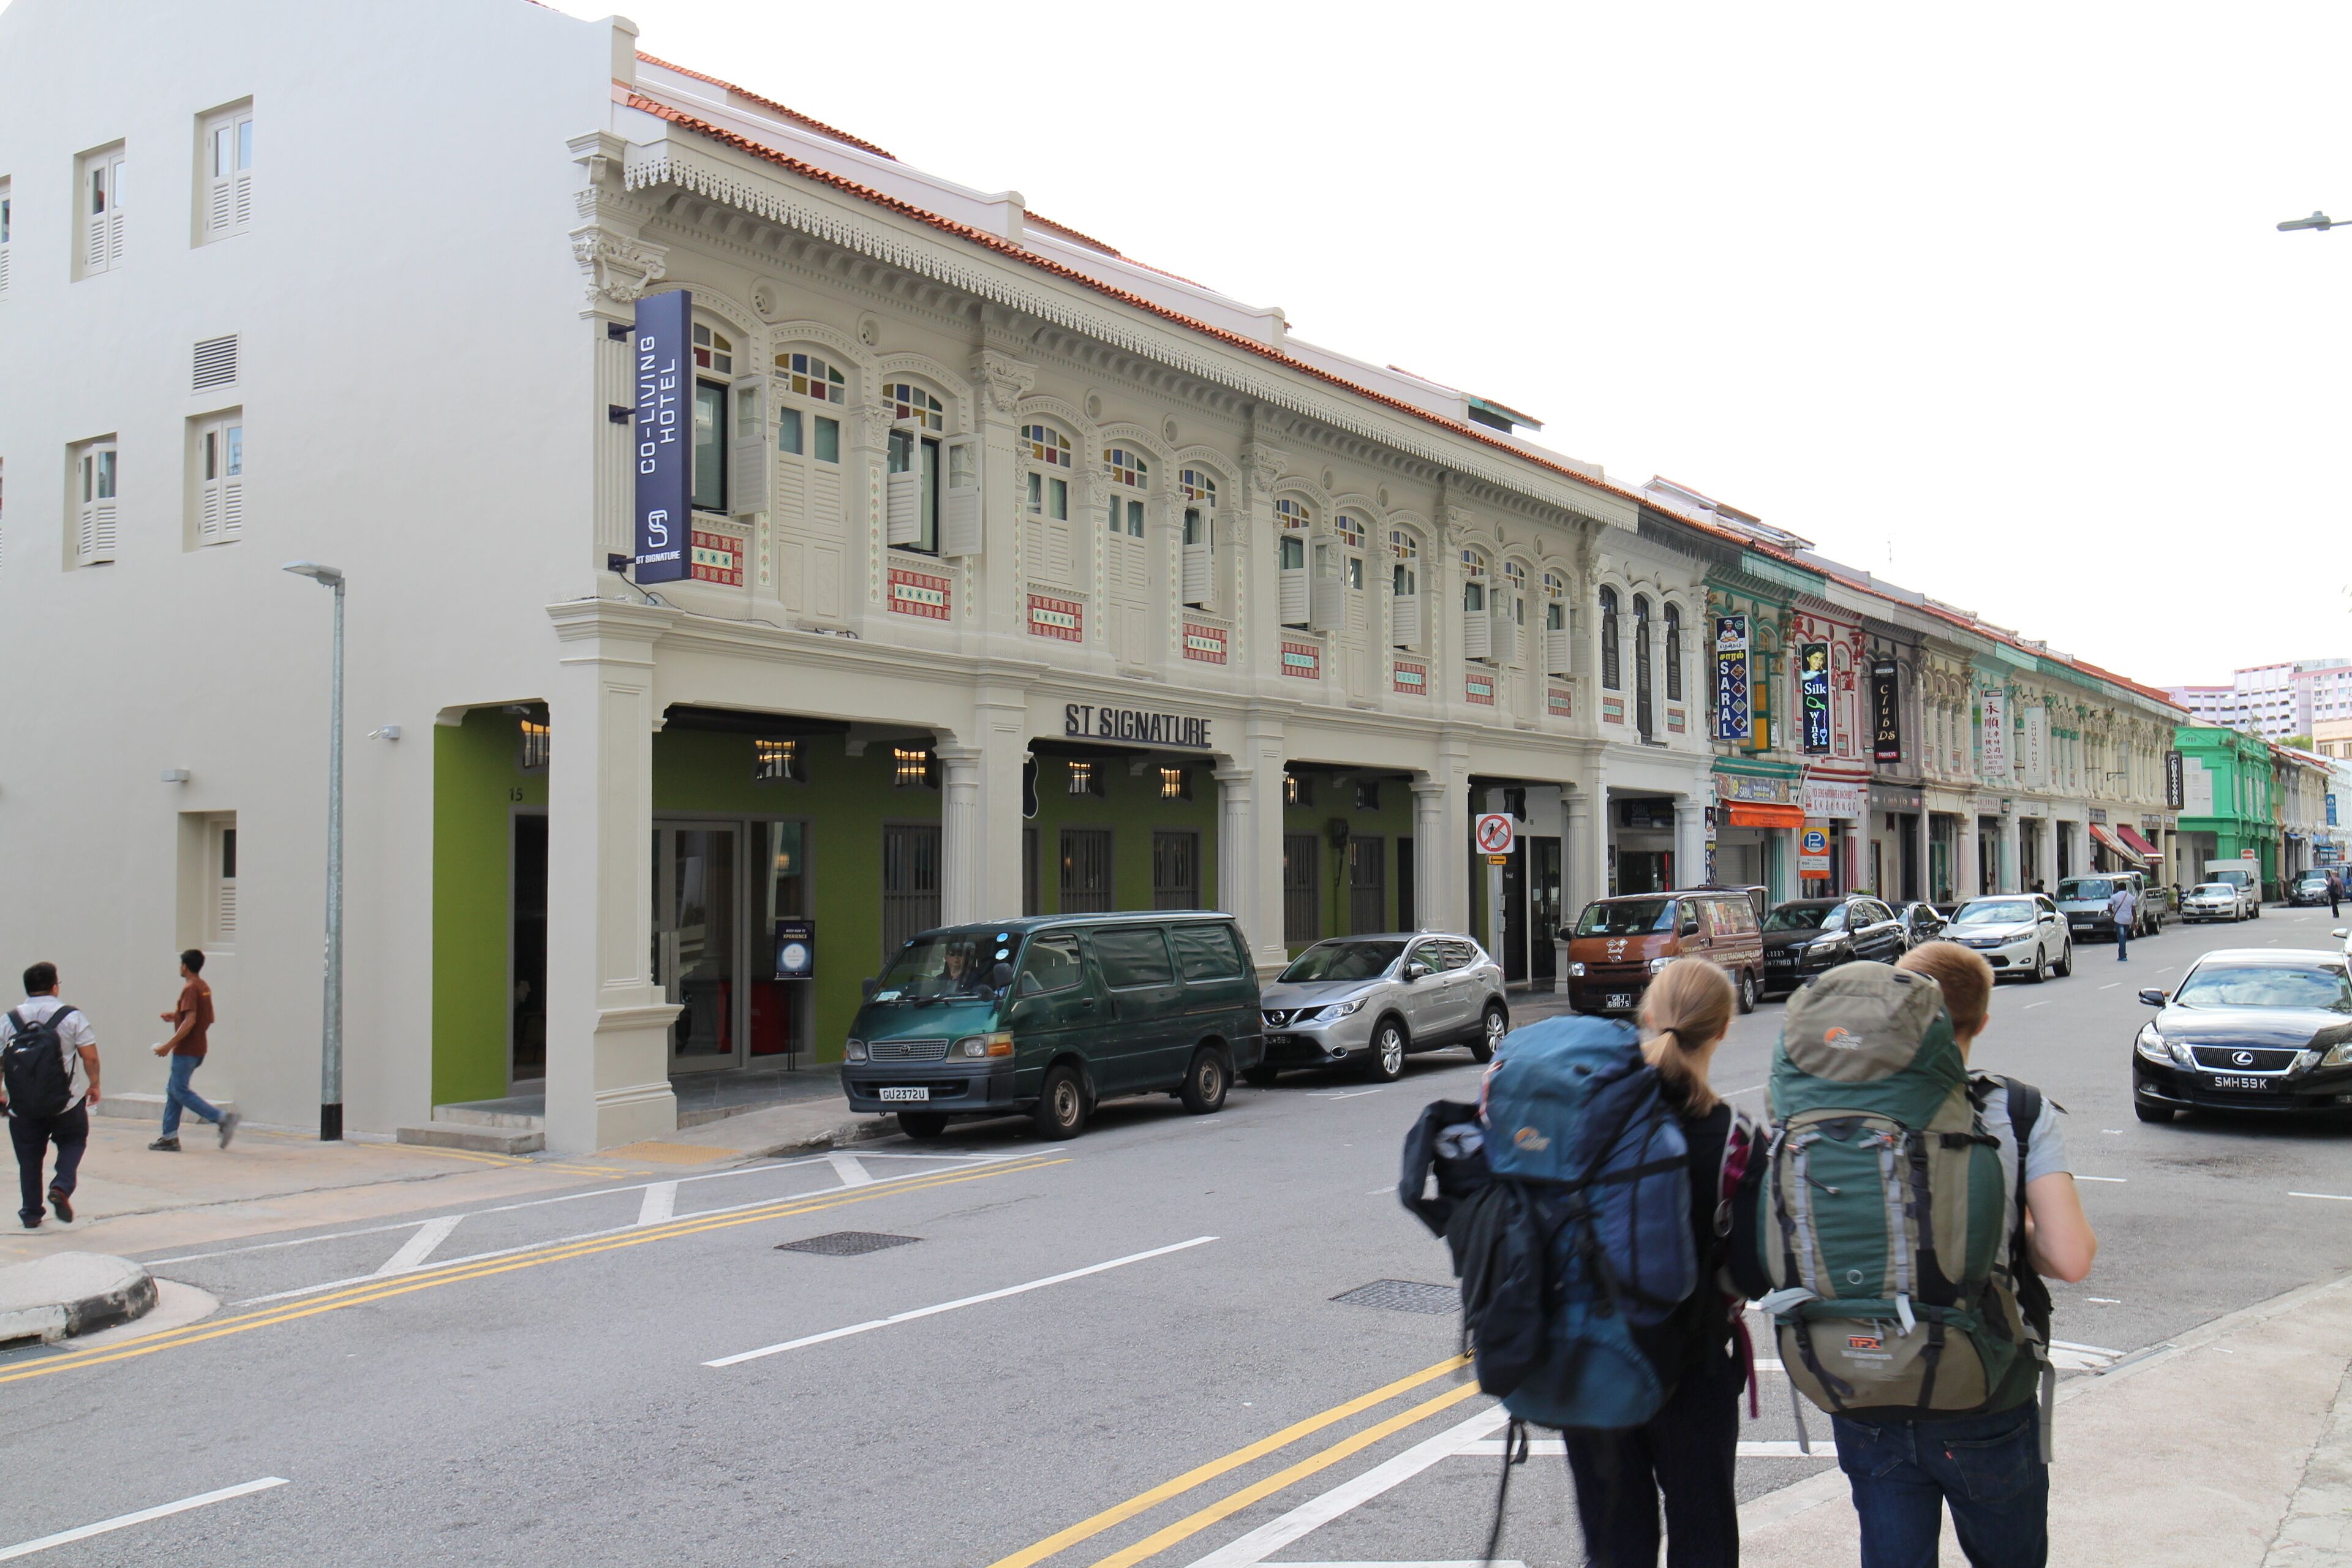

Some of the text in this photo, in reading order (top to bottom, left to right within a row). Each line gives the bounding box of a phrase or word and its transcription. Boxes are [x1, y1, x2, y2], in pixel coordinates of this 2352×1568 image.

[640, 335, 656, 475] CO-LIVING
[660, 358, 676, 444] HOTEL
[636, 550, 680, 565] ST SIGNATURE
[1804, 682, 1826, 695] Silk
[1720, 662, 1730, 736] SARAL
[1880, 684, 1890, 727] Club
[1985, 701, 2000, 729] 永順
[1066, 704, 1212, 747] ST SIGNATURE
[1809, 711, 1820, 746] wines
[1878, 730, 1896, 741] DS
[510, 787, 522, 801] 15
[1740, 786, 1752, 798] SARAL
[1808, 833, 1822, 847] P
[1727, 952, 1744, 960] TRADING
[2215, 1076, 2267, 1089] SMH59K
[883, 1090, 924, 1099] GU2372U
